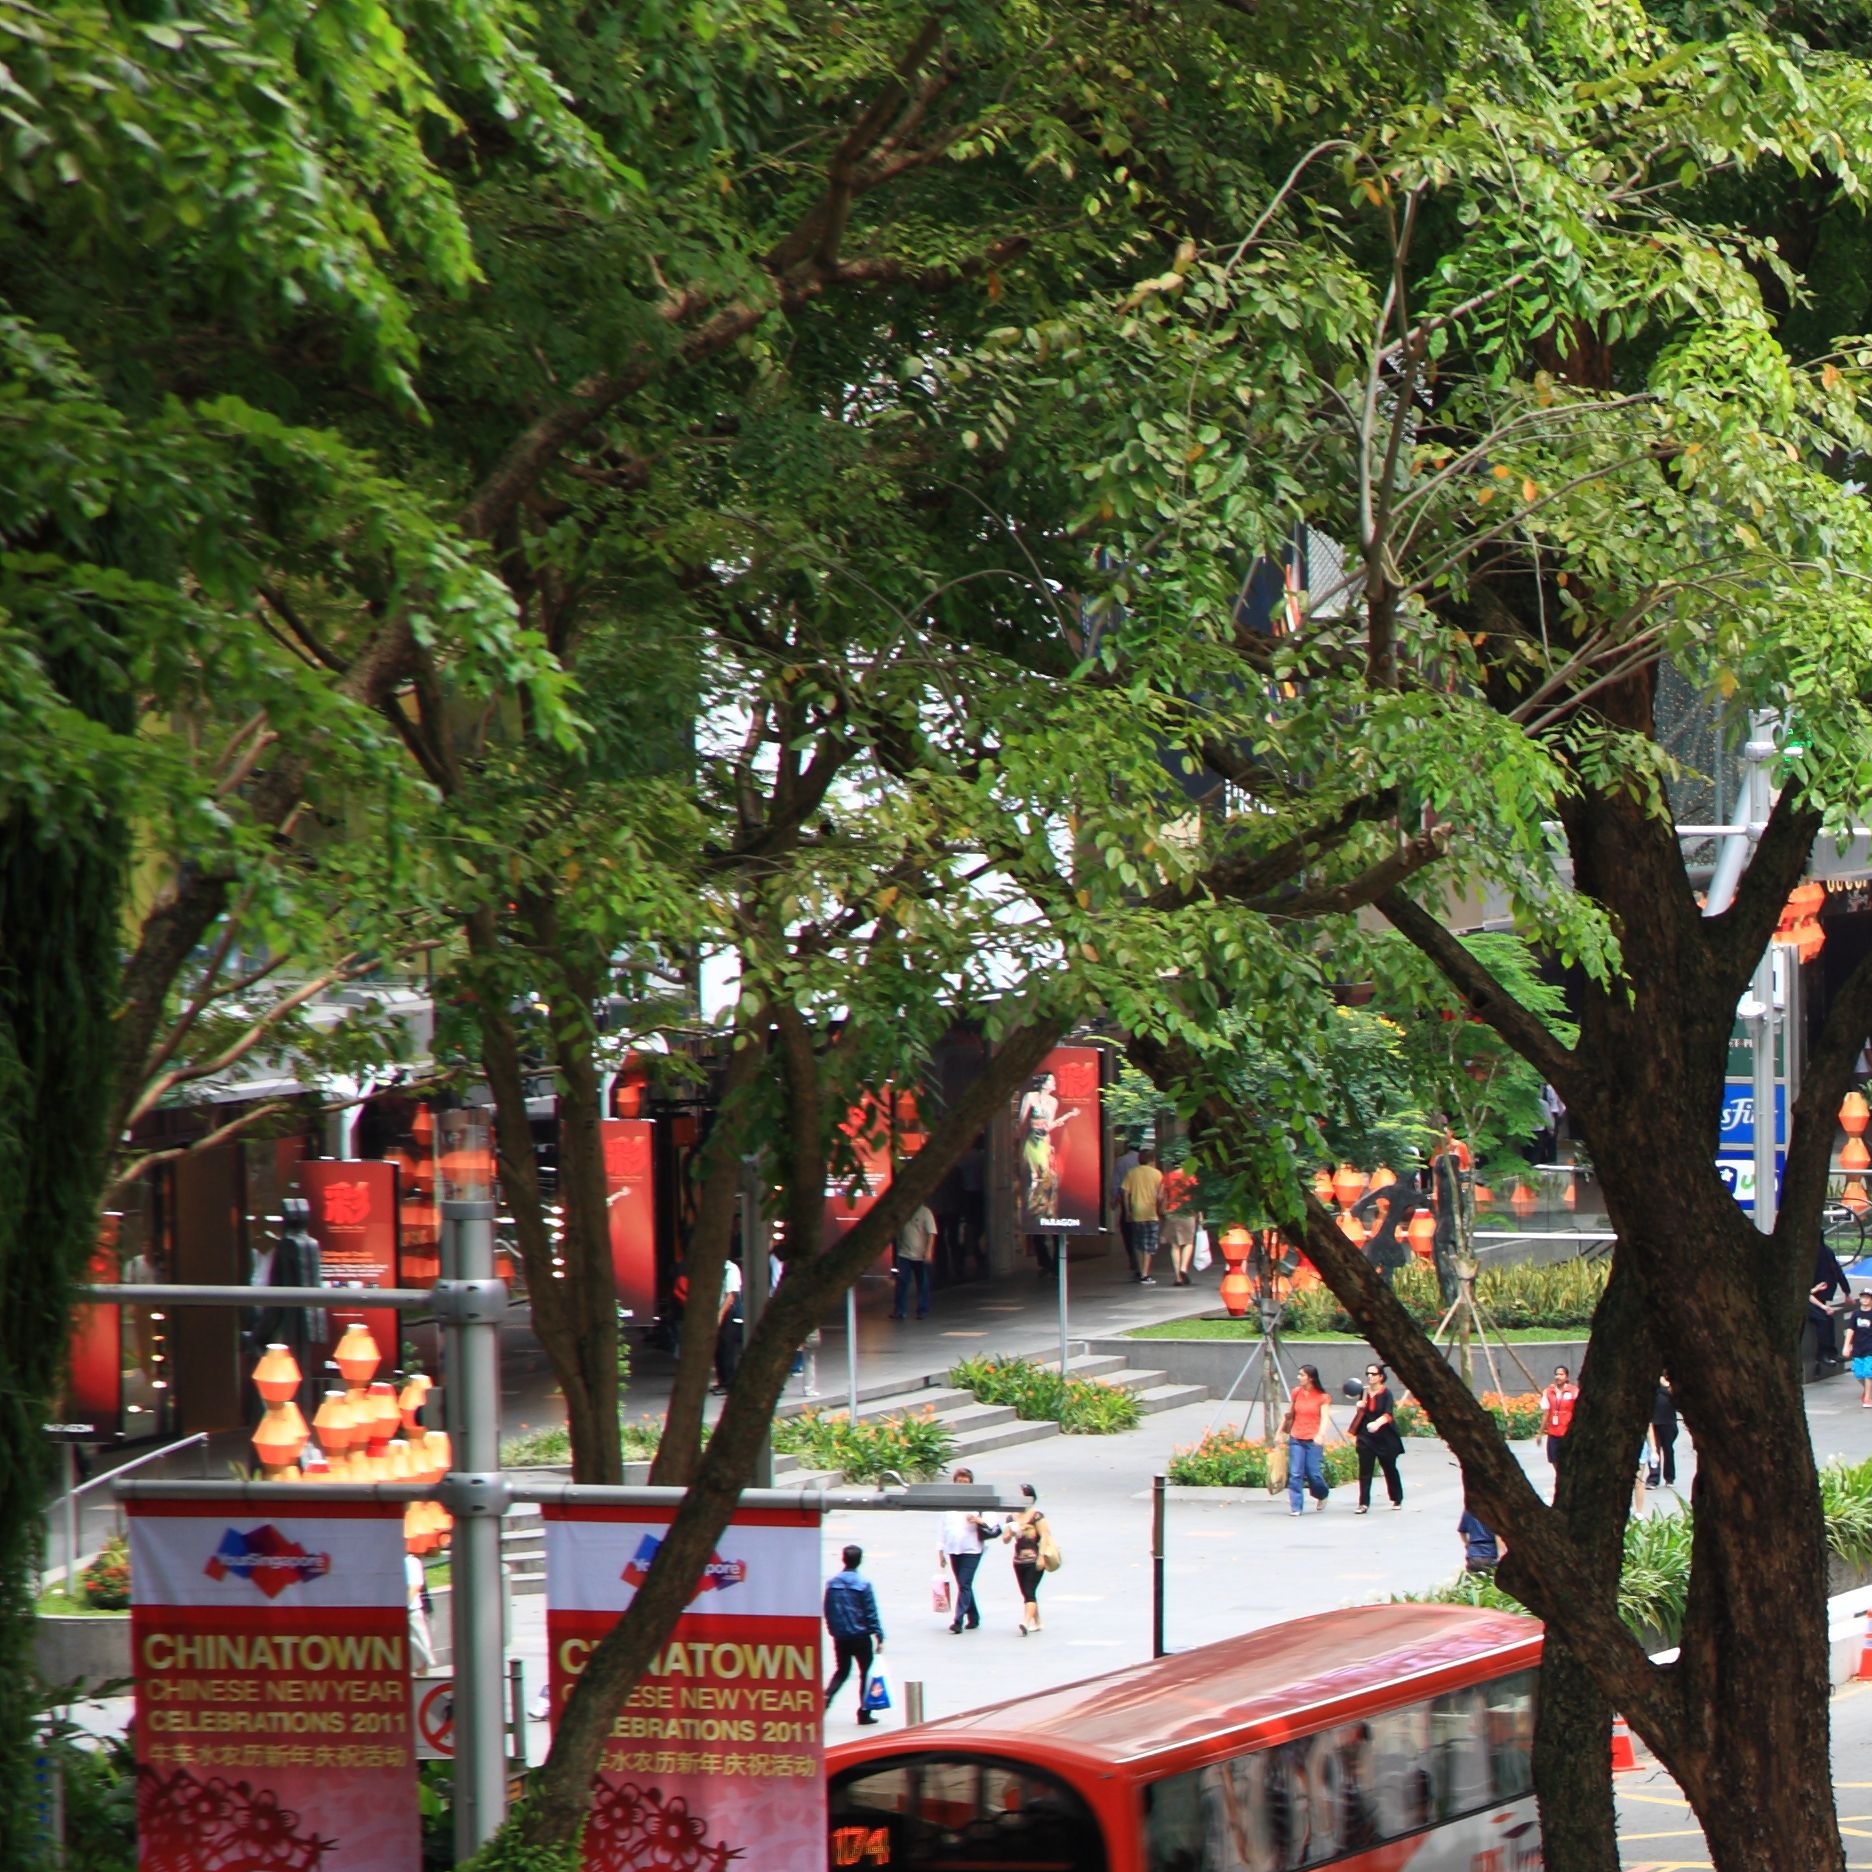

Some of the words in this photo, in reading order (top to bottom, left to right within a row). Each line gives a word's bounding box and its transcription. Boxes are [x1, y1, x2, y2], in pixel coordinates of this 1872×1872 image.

[143, 1632, 403, 1672] CHINATOWN
[145, 1679, 260, 1702] CHINESE
[265, 1680, 330, 1702] NEW
[330, 1681, 404, 1703] YEAR
[679, 1687, 741, 1711] NEW
[740, 1688, 815, 1712] YEAR
[150, 1710, 346, 1733] CELEBRATIONS
[351, 1711, 407, 1733] 2011
[763, 1720, 816, 1743] 2011
[832, 1826, 891, 1867] 174
